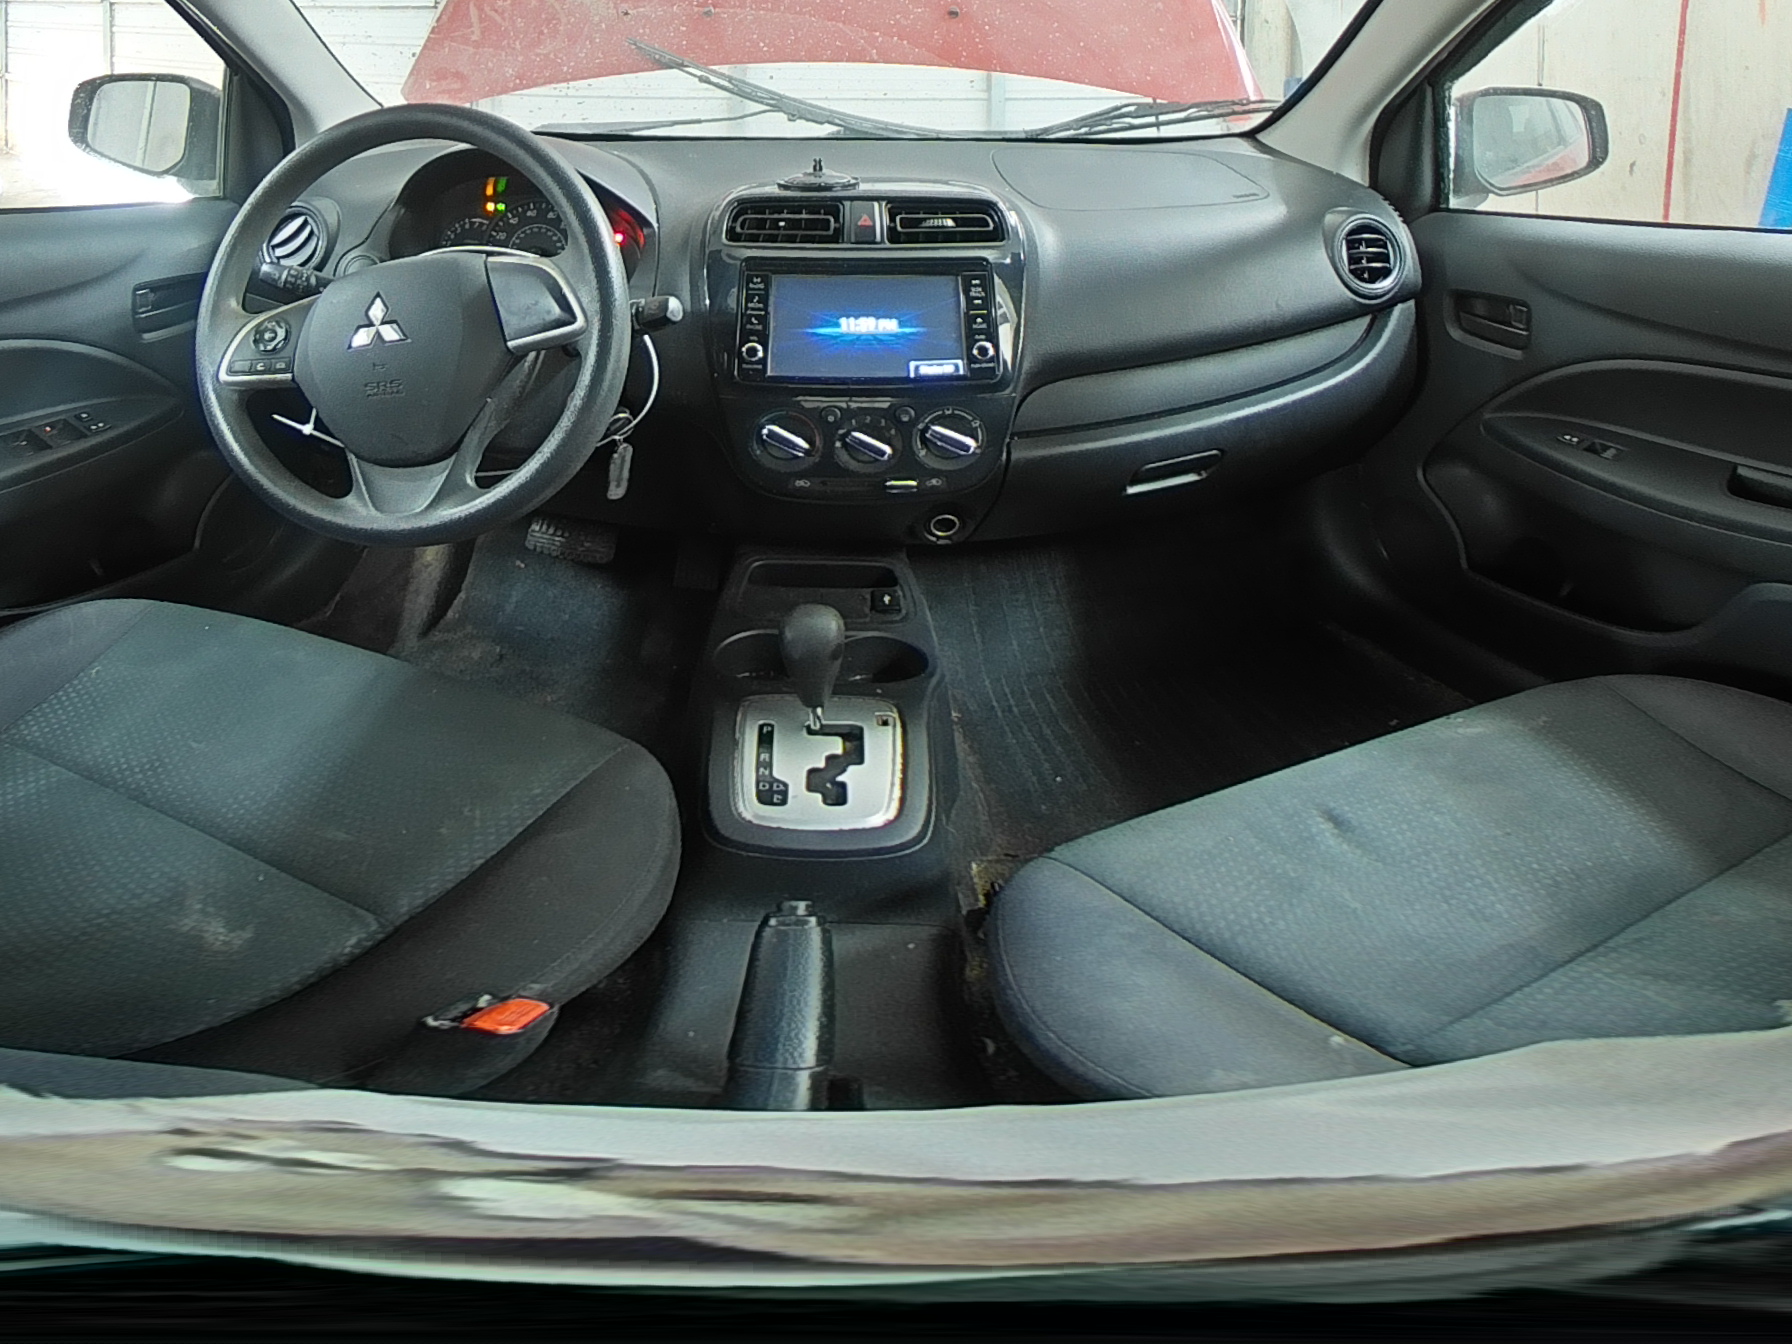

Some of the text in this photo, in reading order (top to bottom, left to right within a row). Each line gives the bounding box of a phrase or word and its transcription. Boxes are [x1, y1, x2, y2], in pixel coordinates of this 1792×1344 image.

[364, 379, 403, 393] SRS
[763, 725, 772, 734] P
[760, 753, 769, 762] R
[759, 782, 769, 790] D
